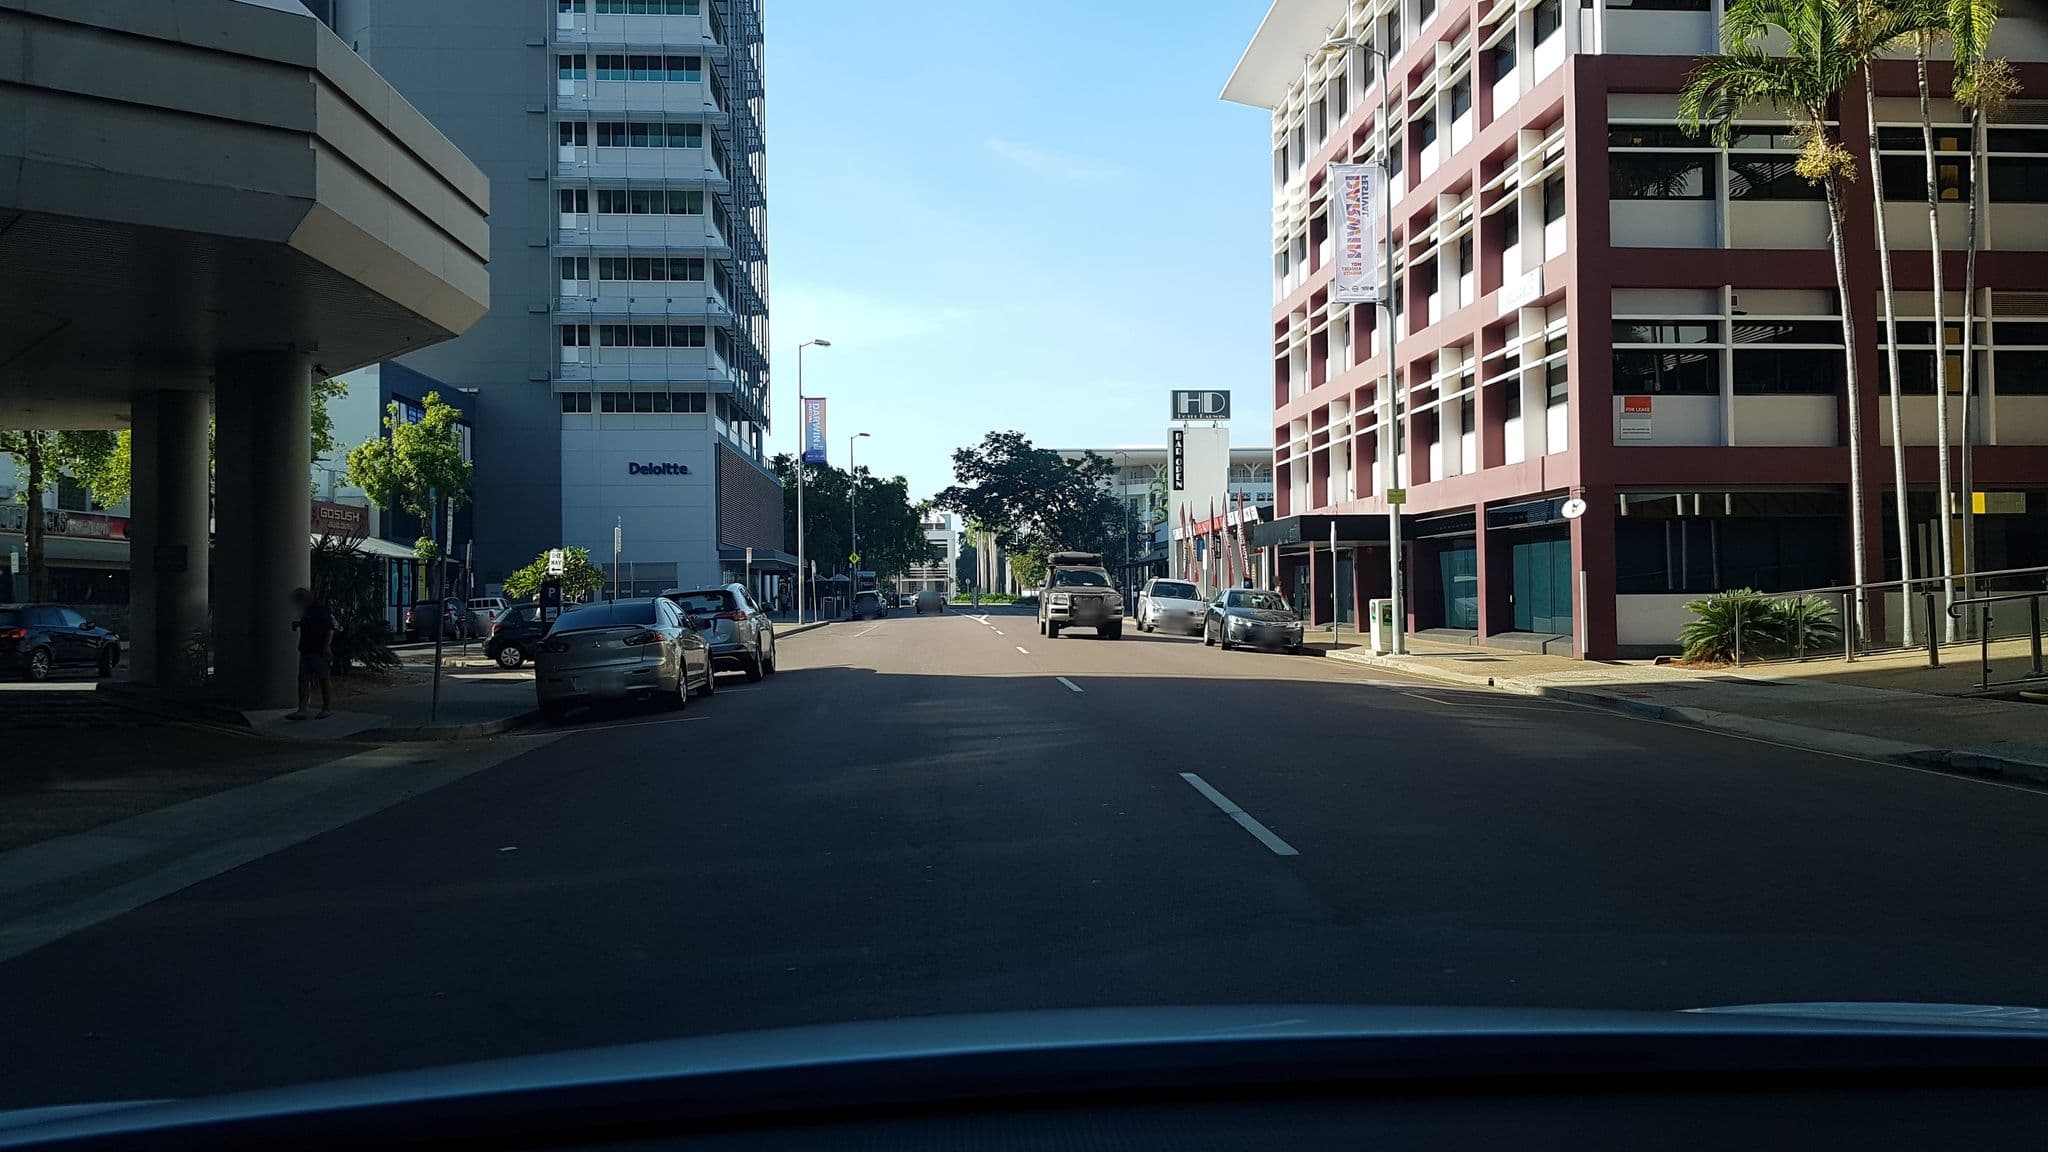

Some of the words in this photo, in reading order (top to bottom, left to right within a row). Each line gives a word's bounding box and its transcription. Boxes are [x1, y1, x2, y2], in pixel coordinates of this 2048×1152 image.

[1177, 391, 1226, 414] HD
[812, 403, 821, 443] DARWIN
[548, 587, 556, 598] P
